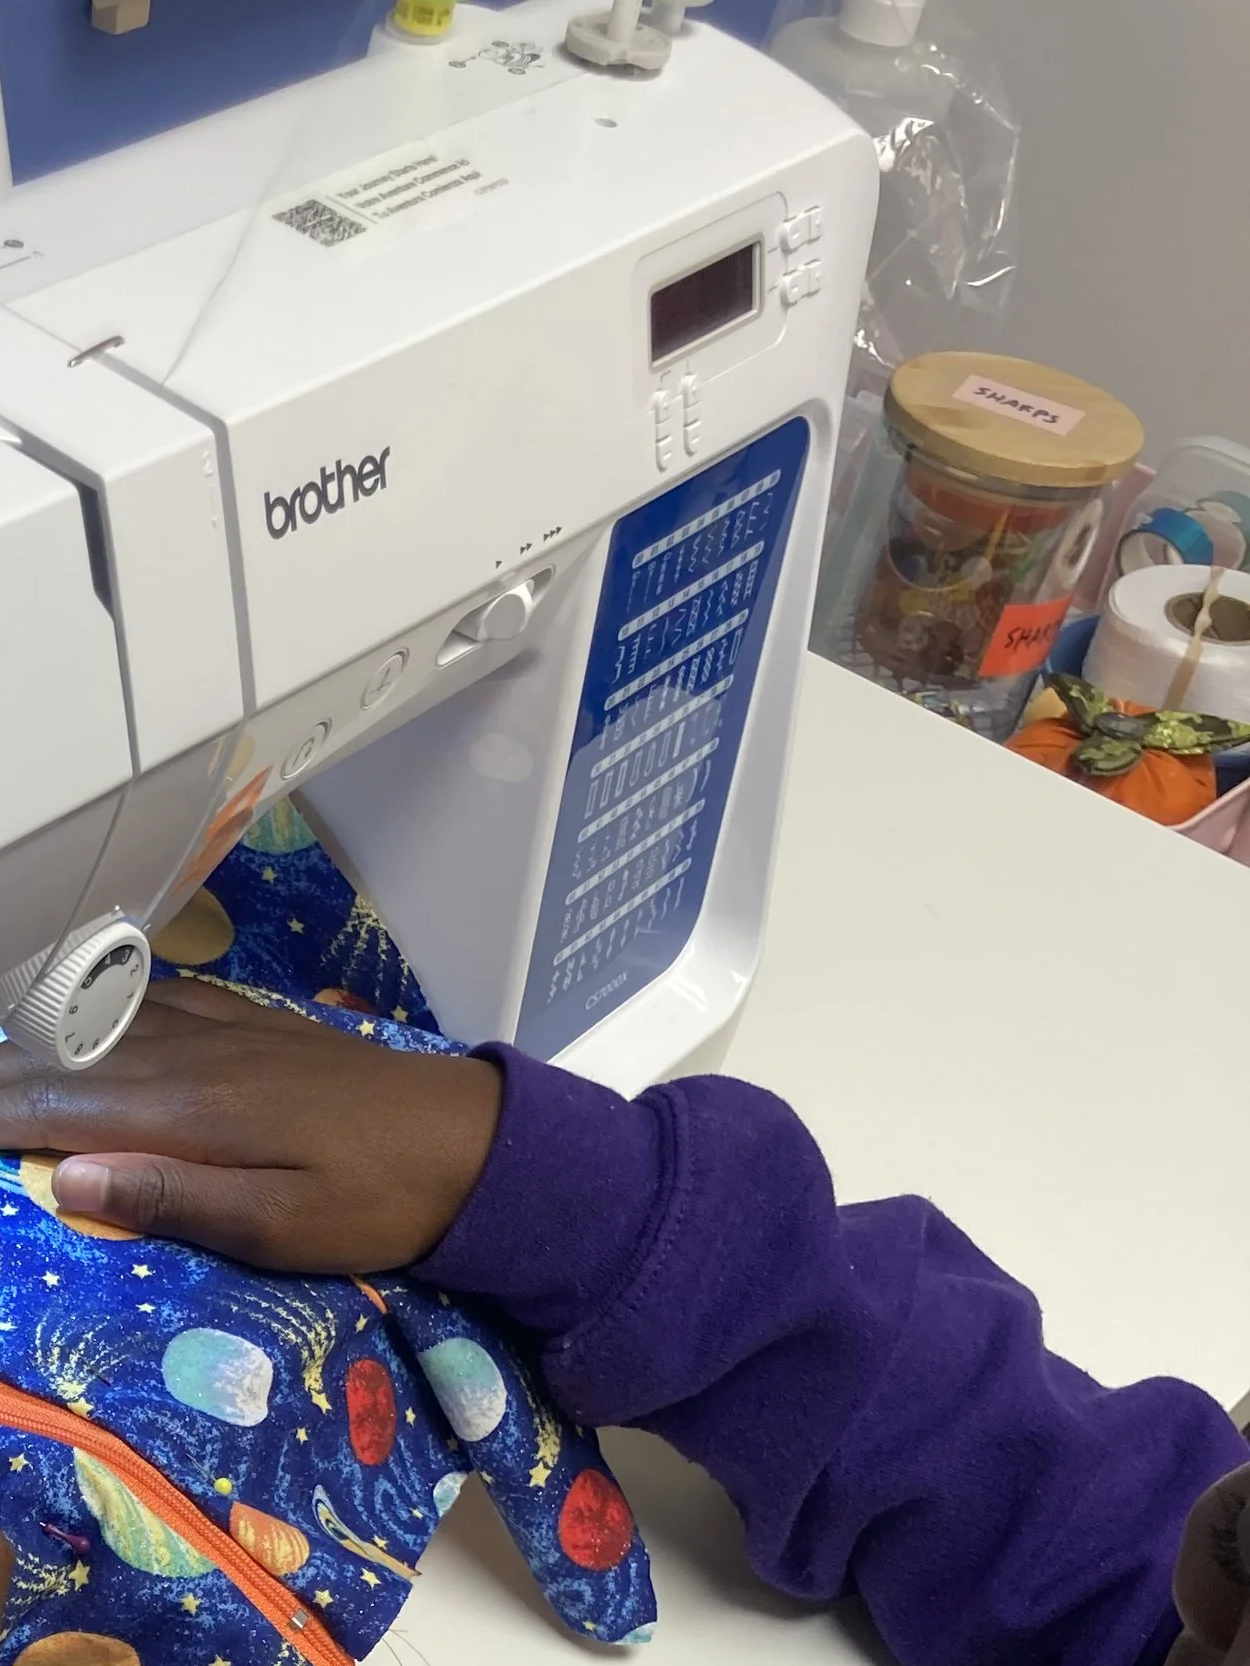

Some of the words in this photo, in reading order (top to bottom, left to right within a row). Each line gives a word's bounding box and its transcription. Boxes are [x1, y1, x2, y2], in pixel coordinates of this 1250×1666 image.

[974, 387, 1060, 424] SHARPS
[263, 446, 390, 540] brother
[121, 948, 131, 964] 3
[68, 1005, 78, 1015] 6
[64, 1032, 76, 1044] 7
